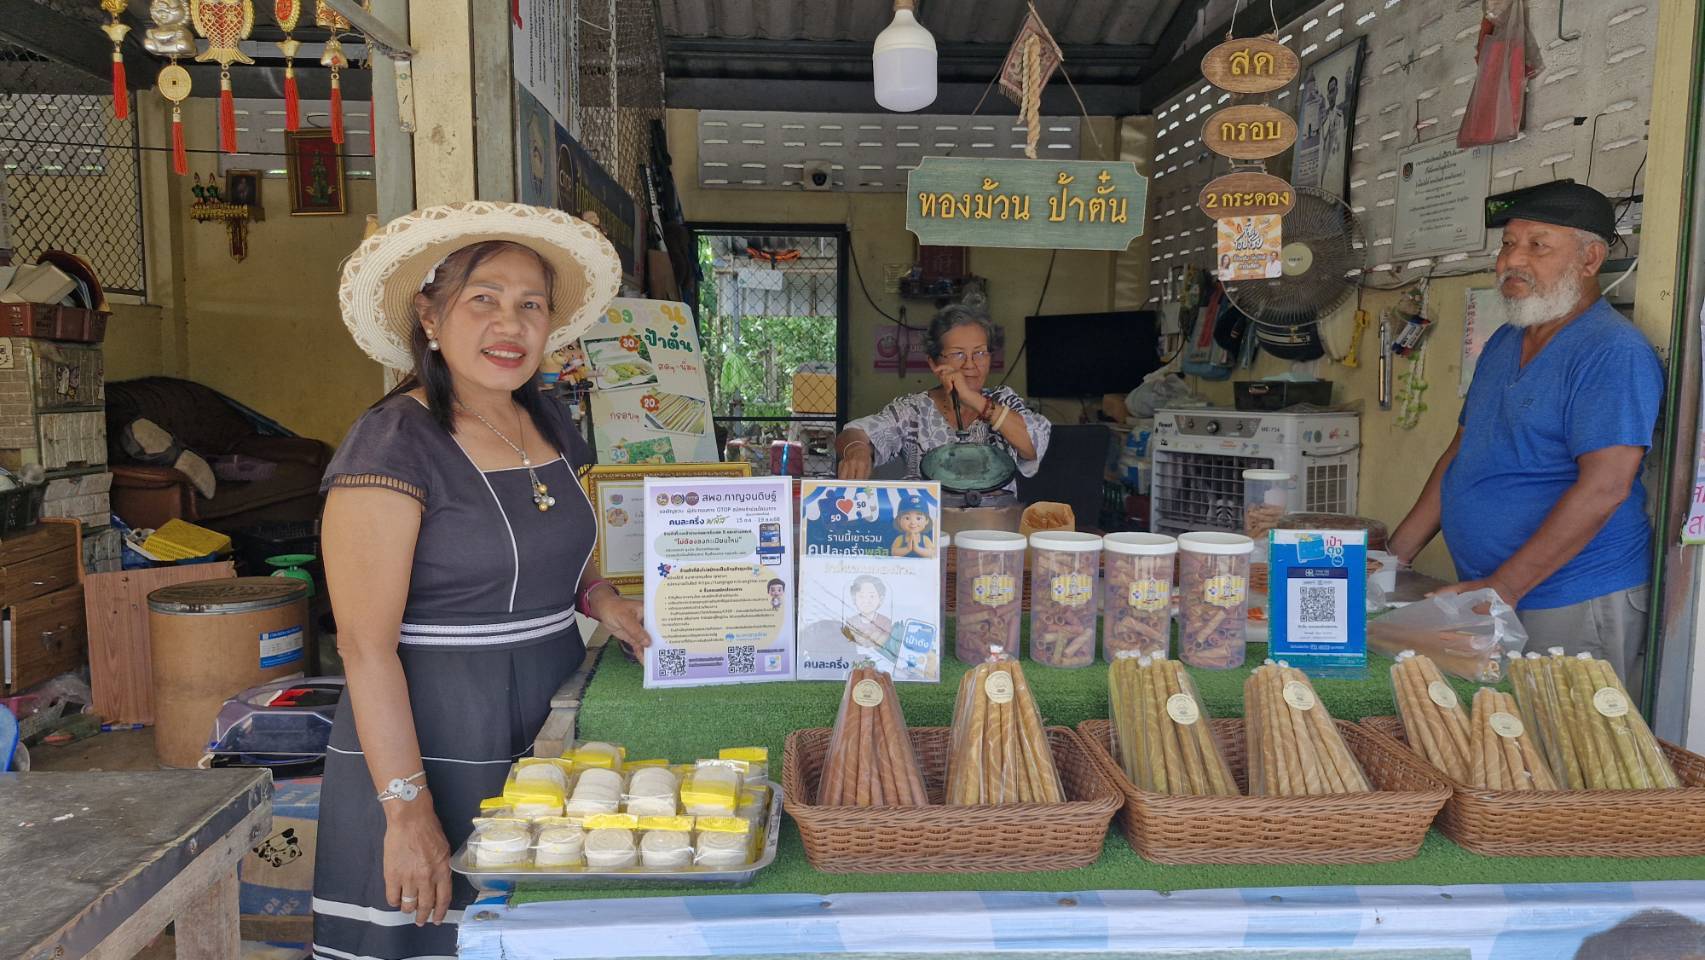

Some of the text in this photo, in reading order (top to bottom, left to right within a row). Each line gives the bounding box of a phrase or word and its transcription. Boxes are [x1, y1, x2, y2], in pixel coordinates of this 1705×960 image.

[1230, 48, 1274, 75] สด
[1222, 121, 1281, 141] กรอบ
[919, 177, 1030, 220] ทองม้วน
[1206, 191, 1290, 208] 2 กระดอง
[857, 501, 867, 509] 50
[668, 516, 705, 525] คนละครึ่ง
[830, 514, 841, 522] 50
[827, 529, 882, 543] ร้านนี้เข้าร่วม
[803, 656, 850, 669] คนละครึ่ง
